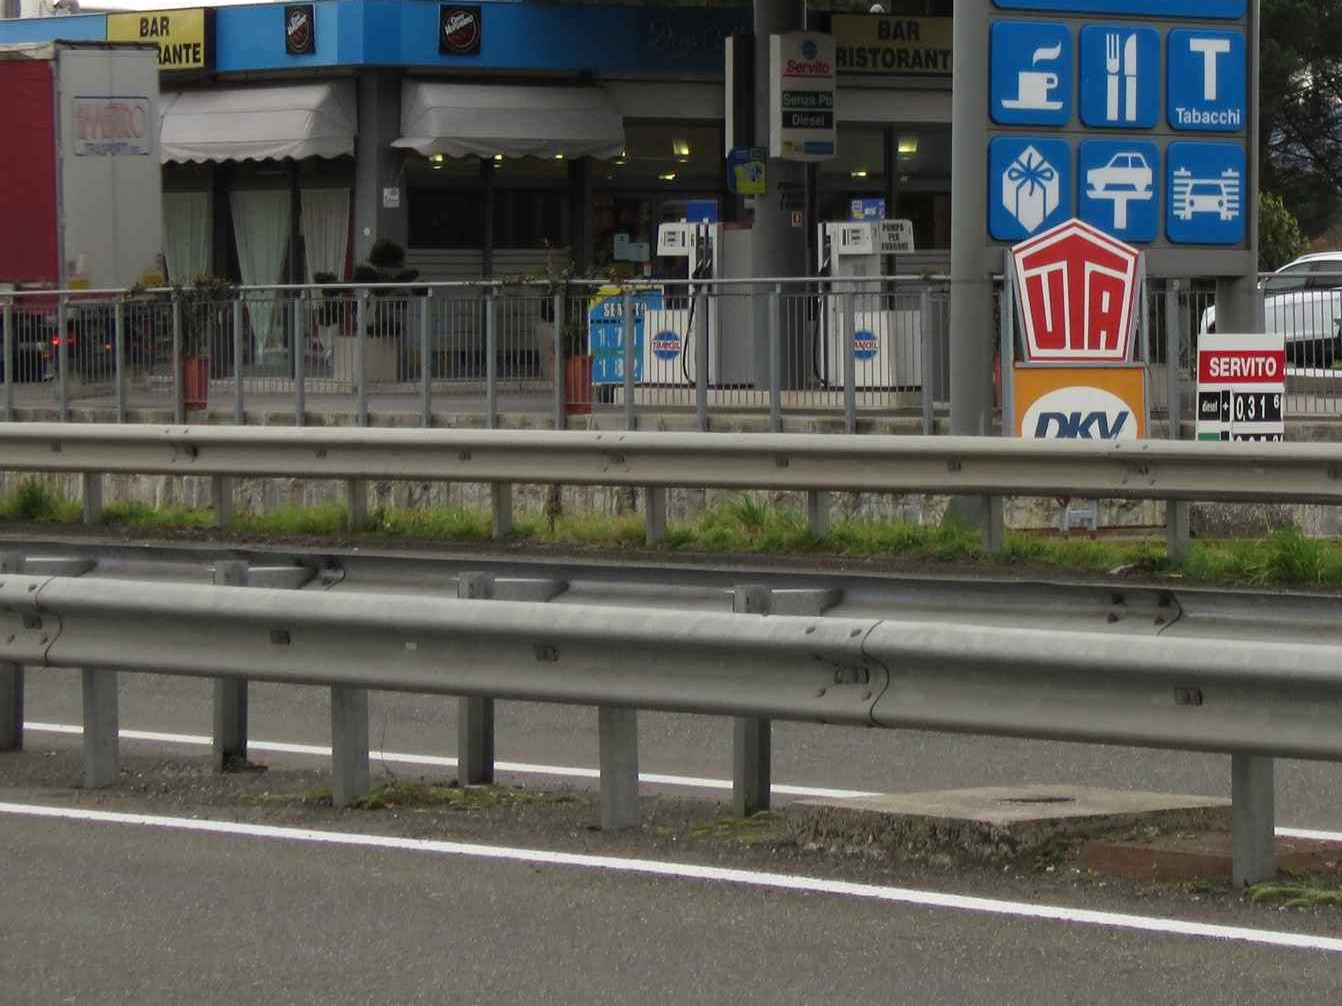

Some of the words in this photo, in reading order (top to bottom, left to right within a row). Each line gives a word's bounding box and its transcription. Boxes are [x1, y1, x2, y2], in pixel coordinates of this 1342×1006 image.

[139, 16, 170, 38] BAR
[878, 20, 920, 42] BAR
[158, 42, 202, 66] RANTE
[836, 46, 953, 70] RISTORANT
[786, 59, 831, 75] Servito
[791, 113, 825, 126] Diesel
[1176, 107, 1240, 126] Tabacchi
[1022, 233, 1128, 351] UTA
[1209, 356, 1277, 377] SERVITO
[1035, 410, 1130, 439] DKV
